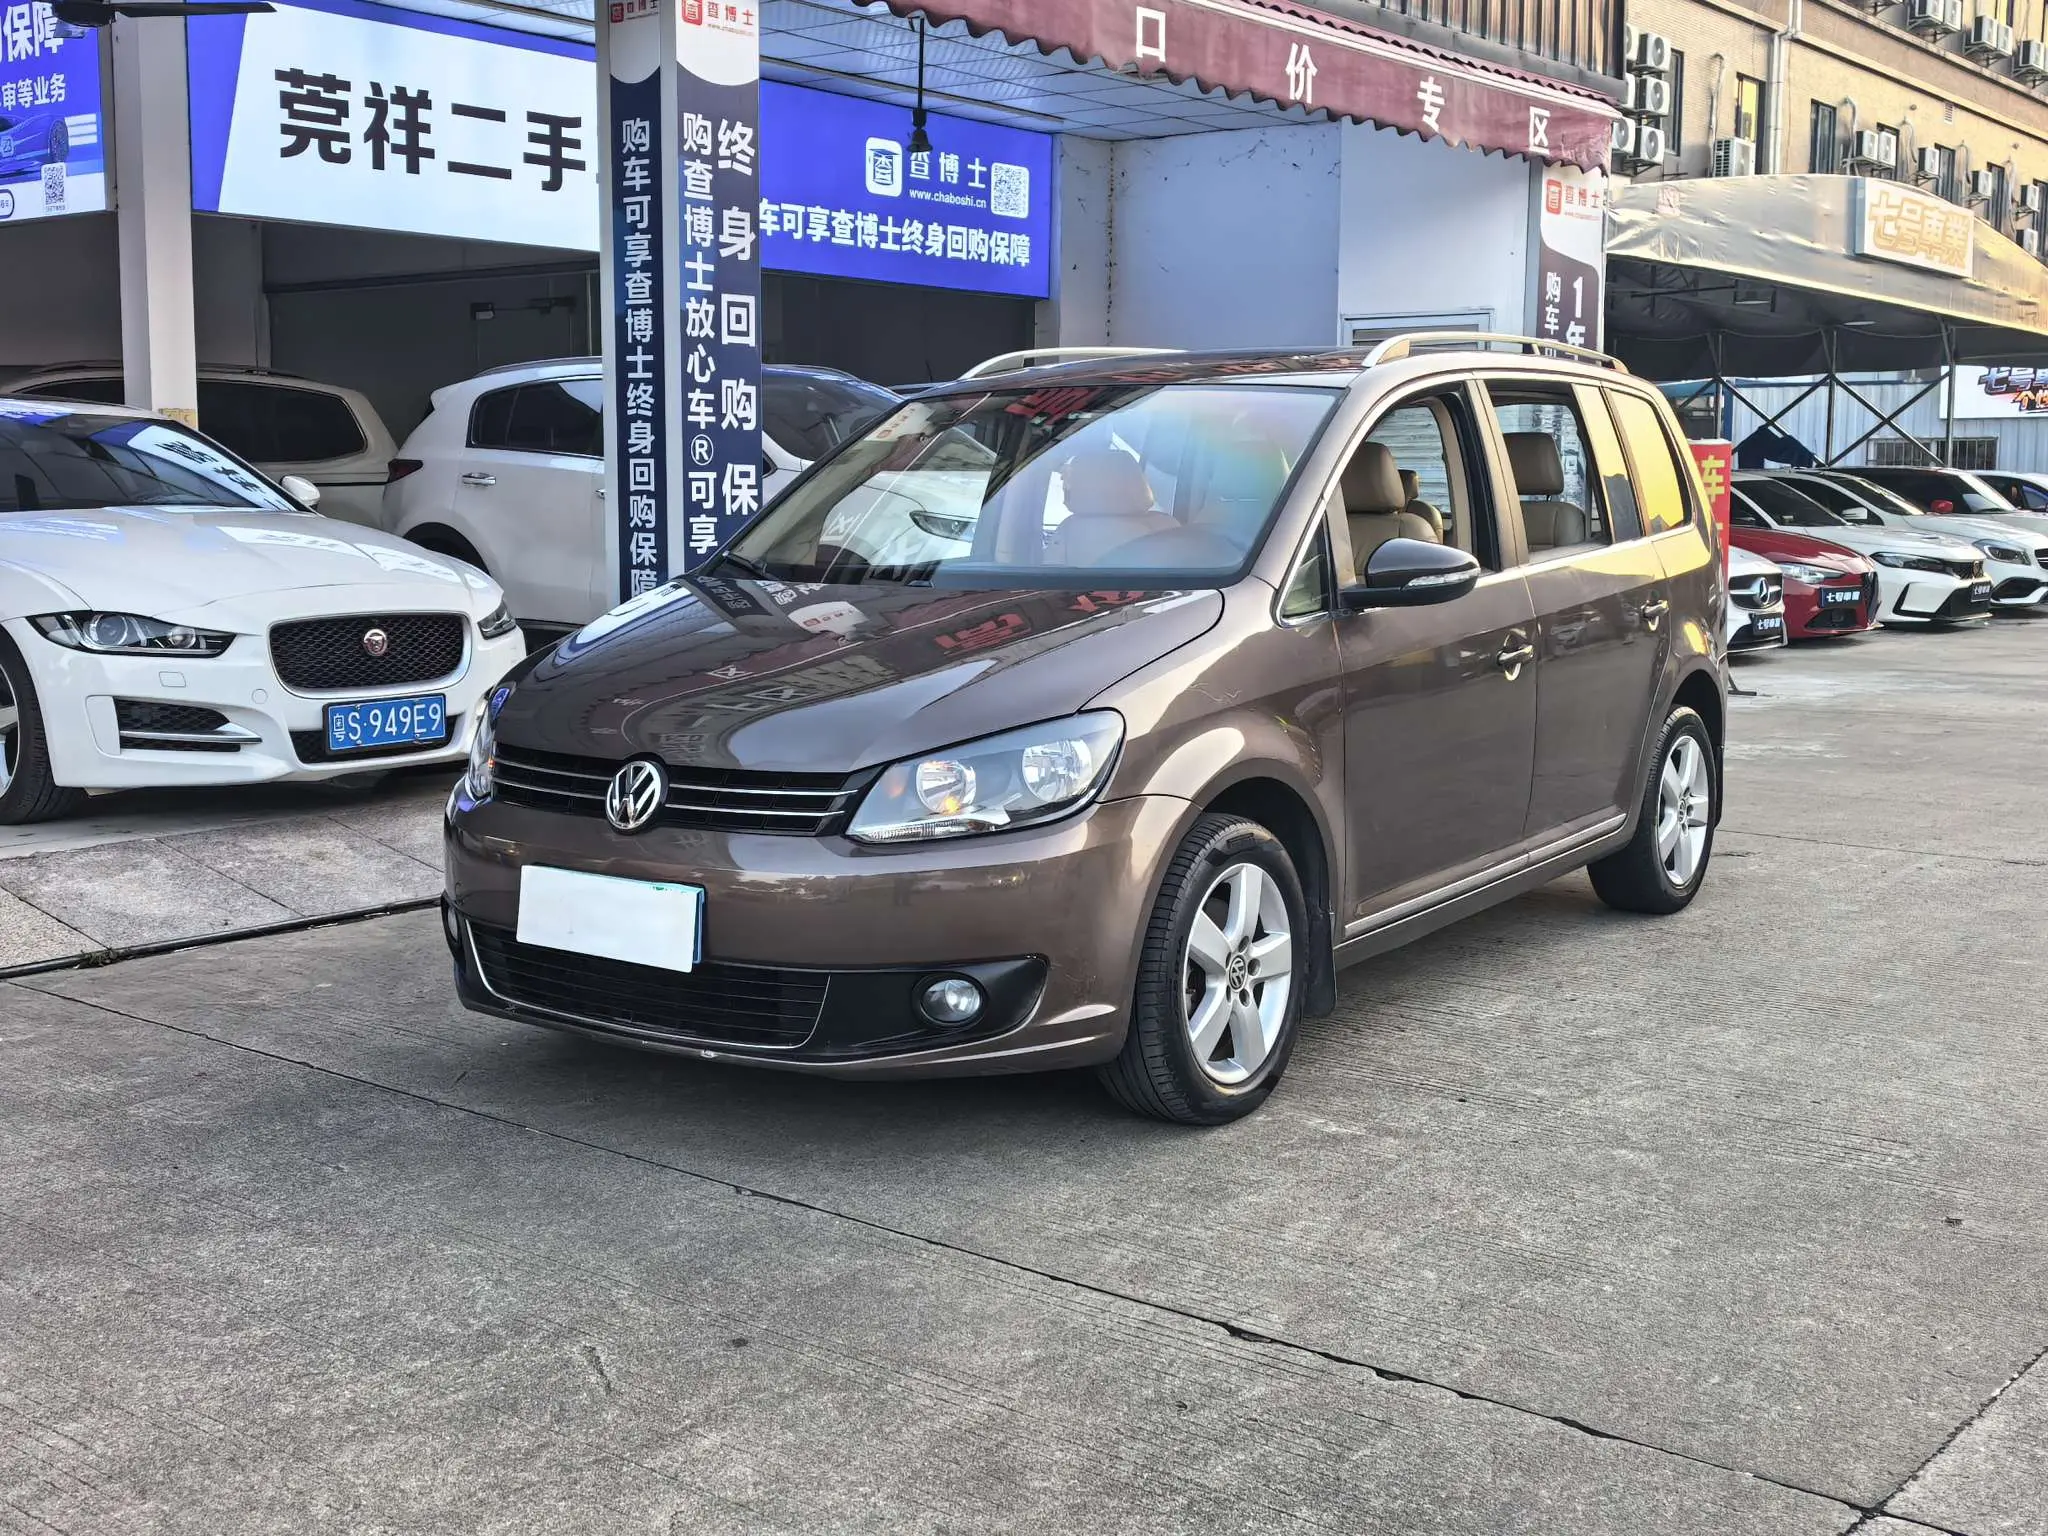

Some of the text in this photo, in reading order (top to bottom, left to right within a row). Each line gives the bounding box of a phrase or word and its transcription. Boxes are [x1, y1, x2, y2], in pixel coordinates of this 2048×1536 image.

[0, 1, 63, 62] 保障
[275, 68, 586, 192] 莞祥二手
[909, 188, 987, 208] www.chaboshi.cn
